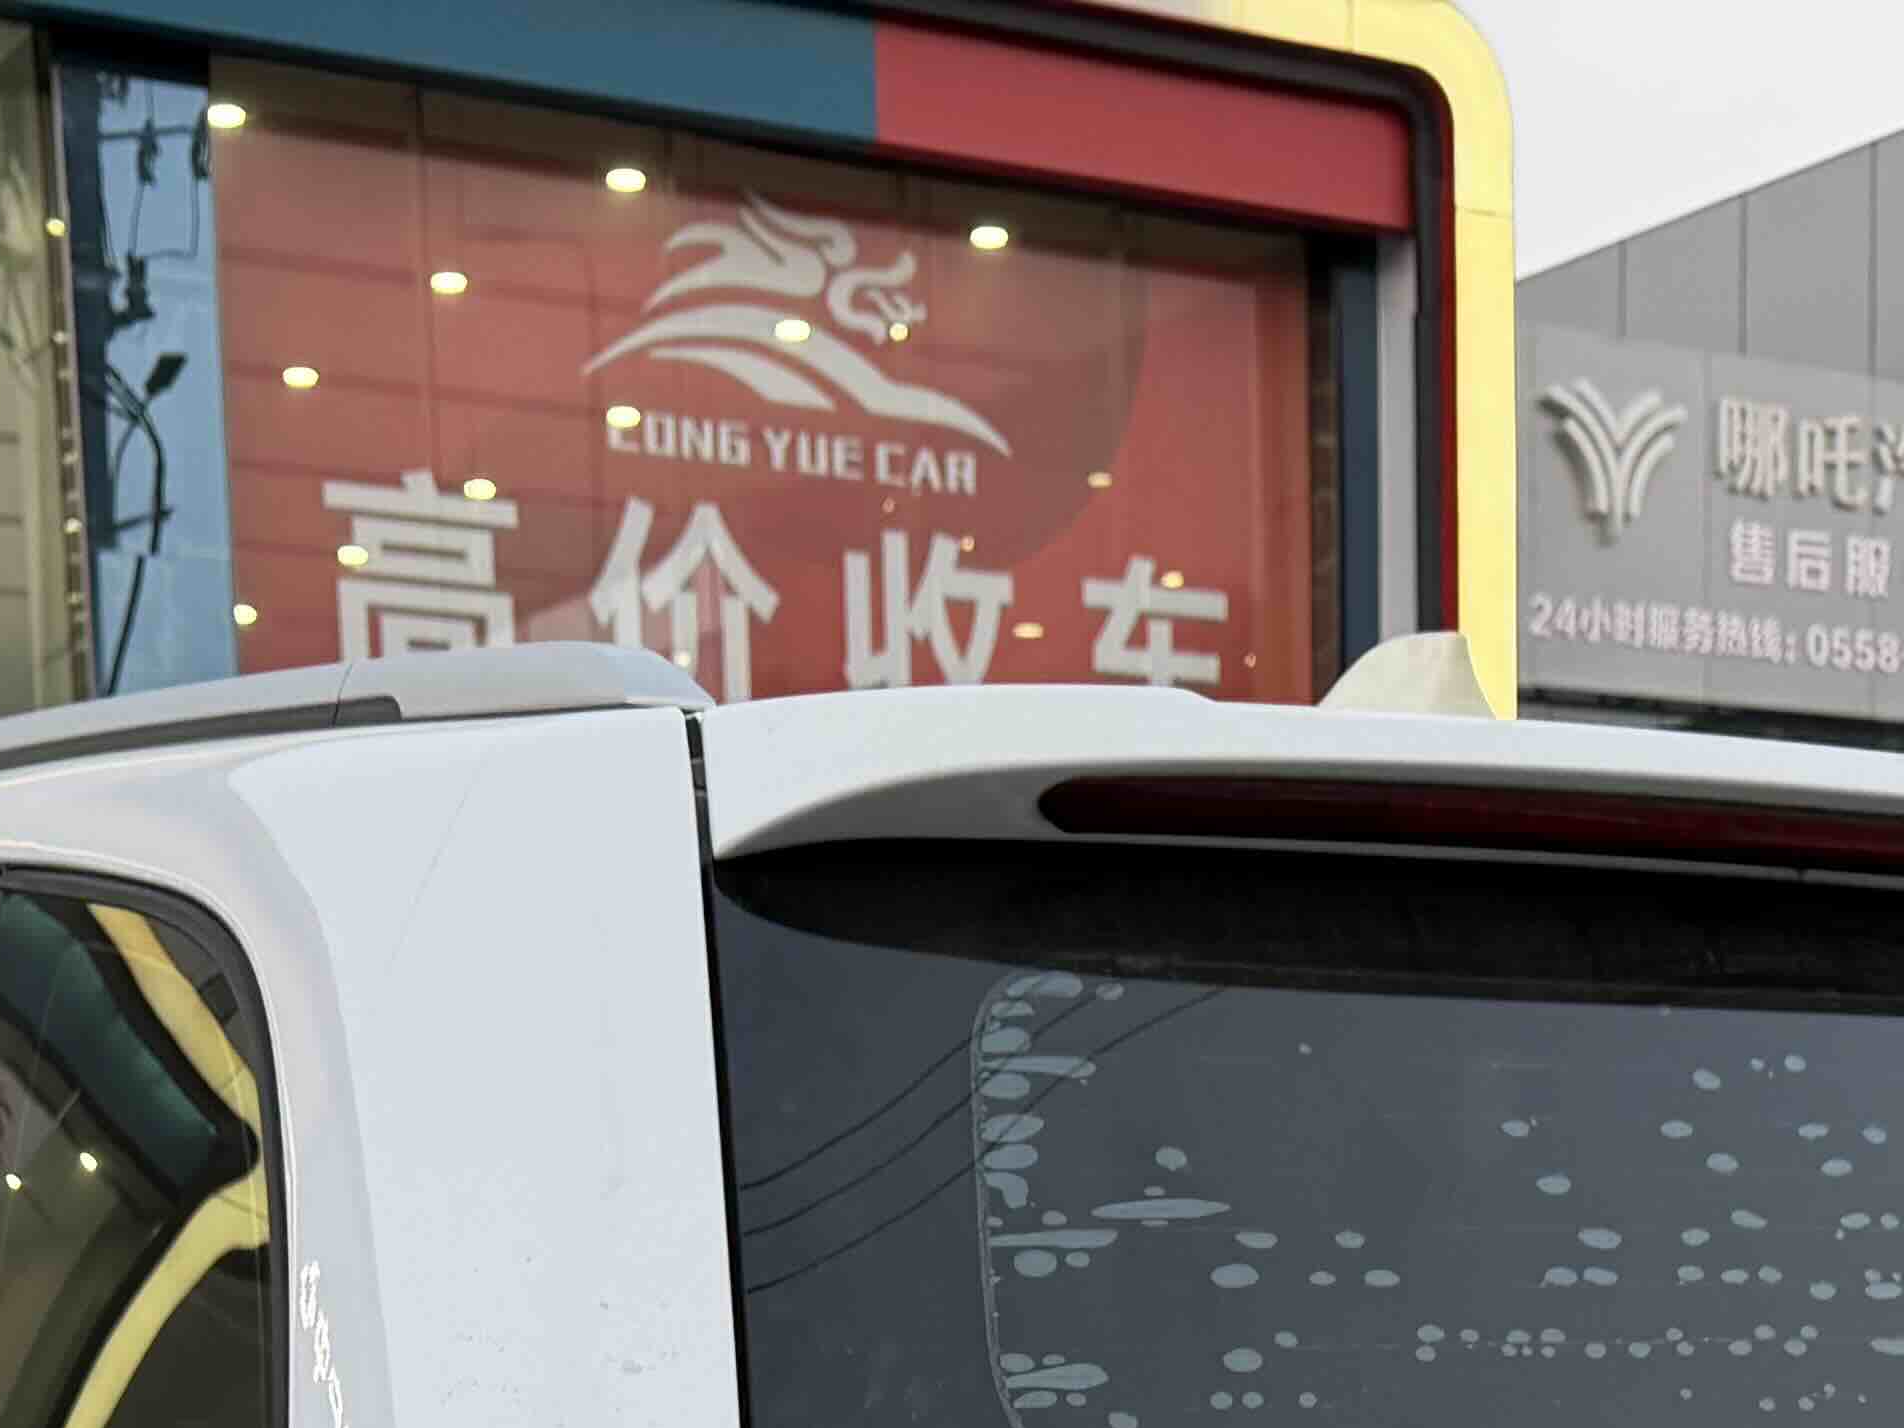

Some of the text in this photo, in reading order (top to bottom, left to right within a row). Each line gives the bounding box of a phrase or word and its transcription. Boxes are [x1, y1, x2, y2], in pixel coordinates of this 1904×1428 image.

[761, 426, 864, 481] YUE
[874, 441, 978, 496] CAR
[322, 470, 1230, 703] 高价收车
